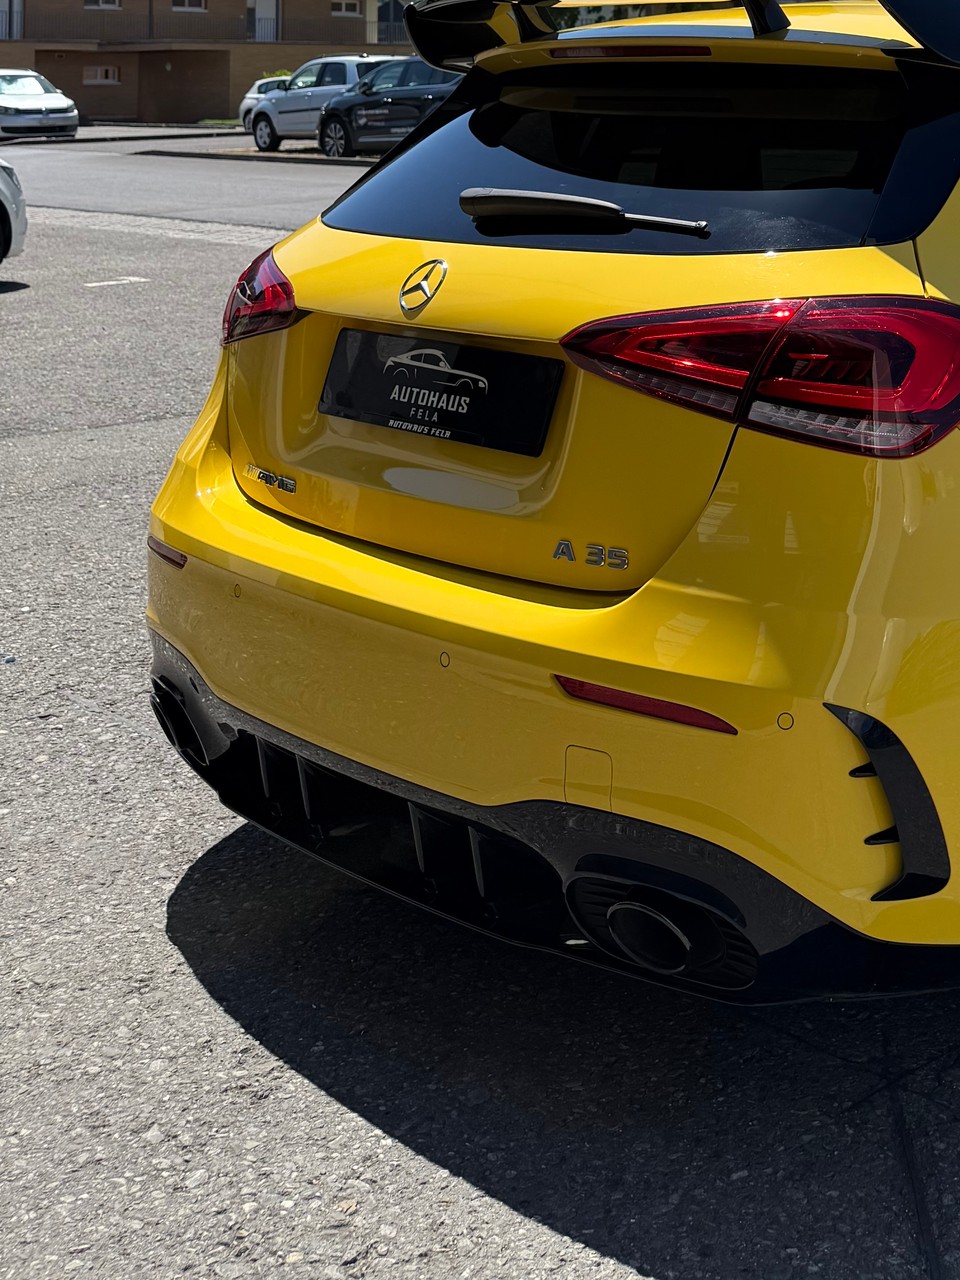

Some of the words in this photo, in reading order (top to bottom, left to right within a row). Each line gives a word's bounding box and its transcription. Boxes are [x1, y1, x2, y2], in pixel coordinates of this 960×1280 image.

[390, 385, 470, 413] AUTOHAUS
[410, 408, 438, 422] FELA
[388, 420, 430, 434] AUTOHAUS
[430, 427, 451, 438] FELA
[552, 540, 576, 562] A
[585, 544, 629, 571] 35
